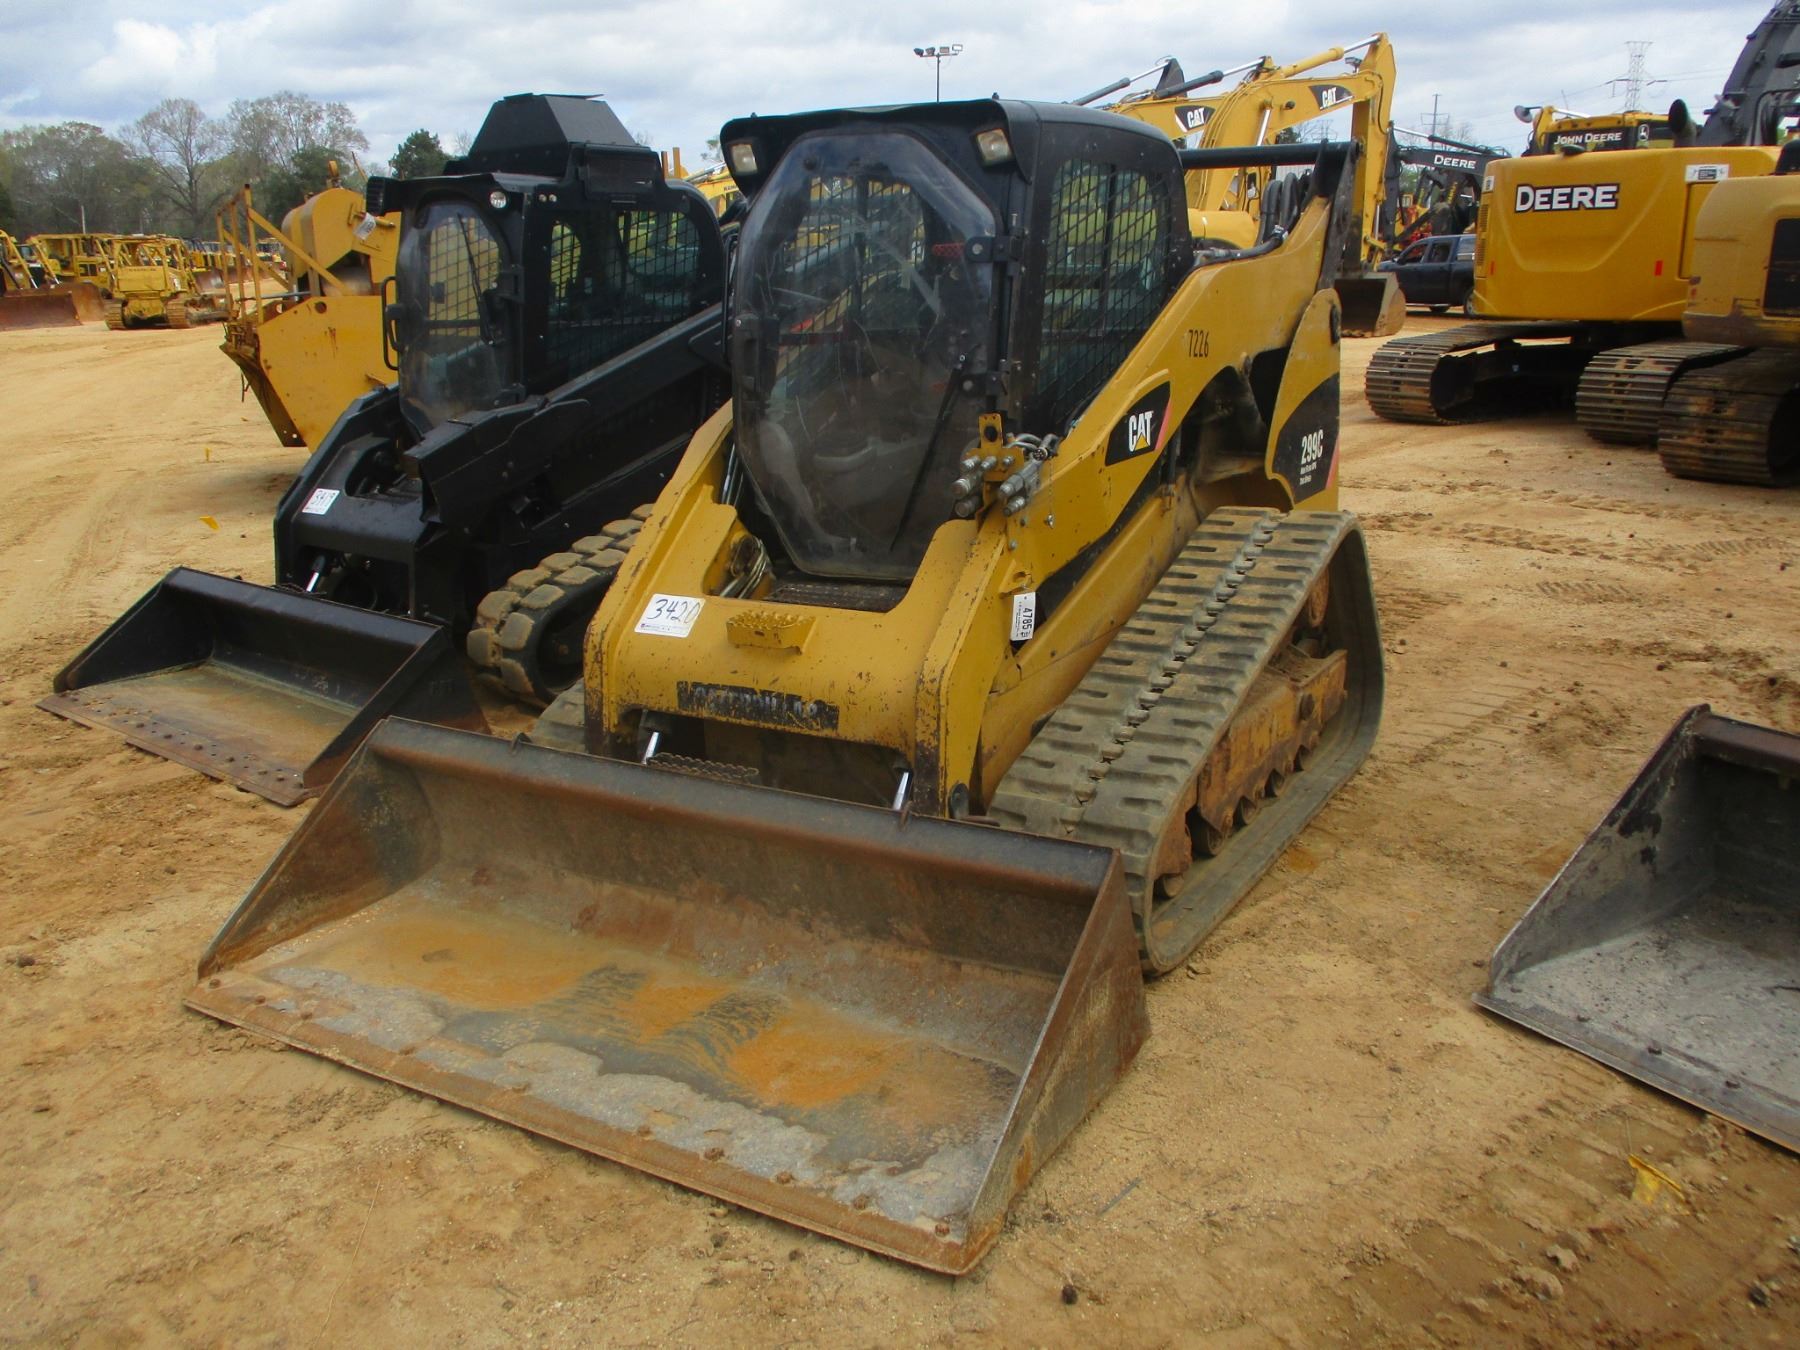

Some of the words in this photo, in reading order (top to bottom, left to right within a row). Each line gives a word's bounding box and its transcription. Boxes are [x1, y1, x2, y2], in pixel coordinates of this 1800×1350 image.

[1321, 87, 1337, 108] CAT
[1186, 107, 1205, 128] CAT
[1433, 154, 1477, 170] DEERE
[1514, 184, 1619, 213] DEERE
[1188, 329, 1210, 358] 7226
[1128, 410, 1154, 452] CAT
[1301, 429, 1324, 465] 299C
[646, 598, 701, 624] 3420
[1022, 607, 1033, 630] 4785
